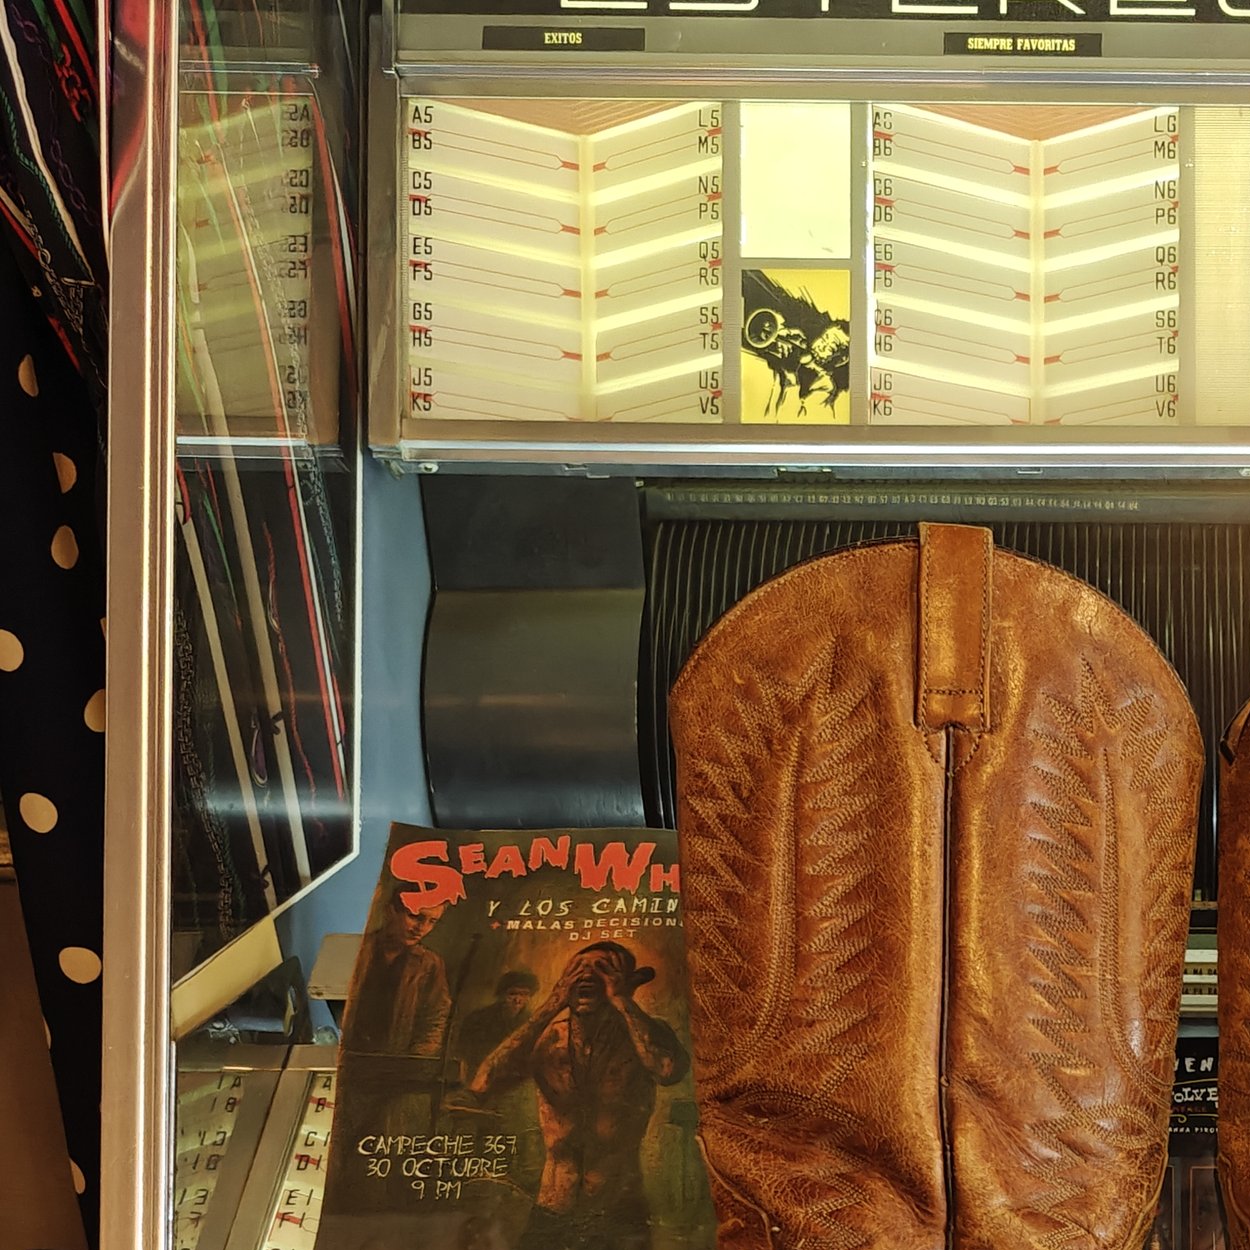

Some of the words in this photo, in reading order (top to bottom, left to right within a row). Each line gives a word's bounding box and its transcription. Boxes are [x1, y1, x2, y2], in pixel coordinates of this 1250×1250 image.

[544, 32, 582, 44] EXITOS
[967, 37, 1013, 50] SIEMPRE
[1017, 38, 1076, 51] FAVORITAS
[412, 106, 433, 124] A5
[698, 109, 720, 128] L5
[412, 132, 433, 150] B5
[698, 136, 720, 154] M5
[1155, 141, 1176, 160] M6
[412, 172, 433, 190] C5
[699, 175, 720, 194] N5
[1155, 180, 1176, 199] N6
[412, 198, 433, 216] D5
[699, 202, 720, 220] P5
[1155, 207, 1176, 224] P6
[412, 237, 433, 255] E5
[699, 242, 720, 260] Q5
[412, 263, 433, 280] F5
[1155, 272, 1176, 290] R6
[412, 303, 433, 320] G5
[699, 306, 720, 325] S5
[412, 329, 433, 346] H5
[412, 368, 433, 386] J5
[1155, 375, 1176, 393] U6
[412, 394, 433, 412] K5
[699, 397, 720, 415] V5
[390, 835, 572, 915] SEAN
[486, 900, 501, 917] Y
[519, 898, 573, 917] LOS
[506, 918, 574, 931] MALAS
[569, 931, 592, 942] DJ
[600, 929, 638, 940] SET
[358, 1135, 474, 1155] CAMPECHE
[483, 1135, 517, 1154] 367
[366, 1157, 391, 1177] 30
[402, 1157, 508, 1178] OCTUBRE
[411, 1180, 425, 1200] 9
[435, 1180, 462, 1200] PM
